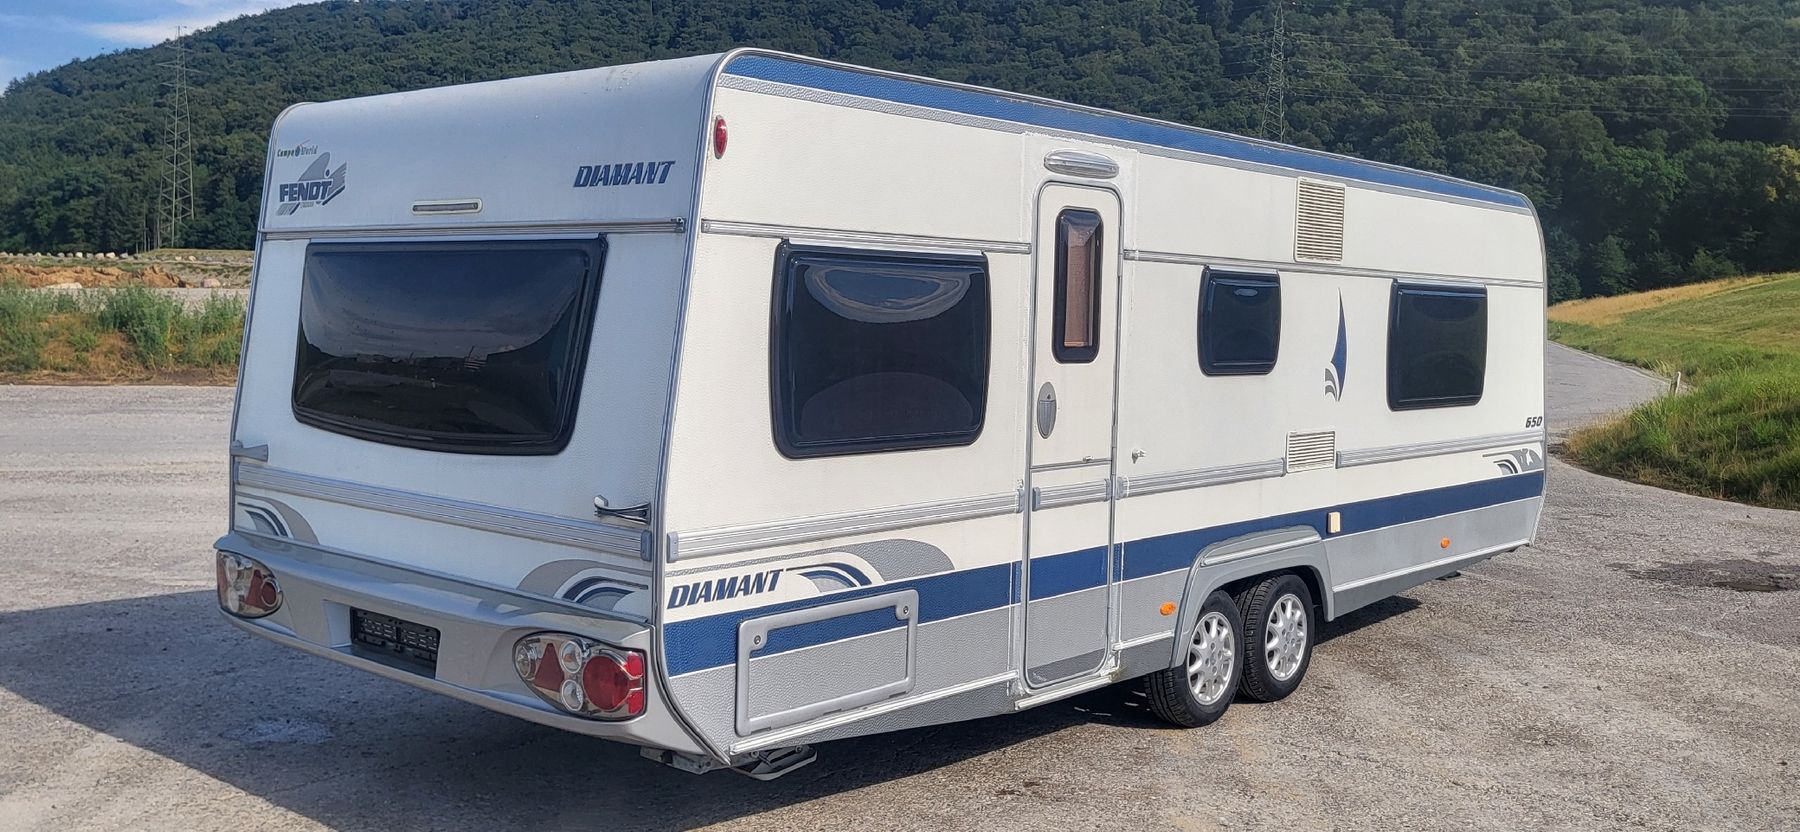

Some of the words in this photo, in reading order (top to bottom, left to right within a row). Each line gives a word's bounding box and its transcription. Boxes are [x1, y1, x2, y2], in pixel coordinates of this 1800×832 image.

[573, 160, 676, 187] DIAMANT
[279, 181, 332, 202] FENDT
[1525, 416, 1543, 428] 650
[667, 569, 784, 609] DIAMANT
